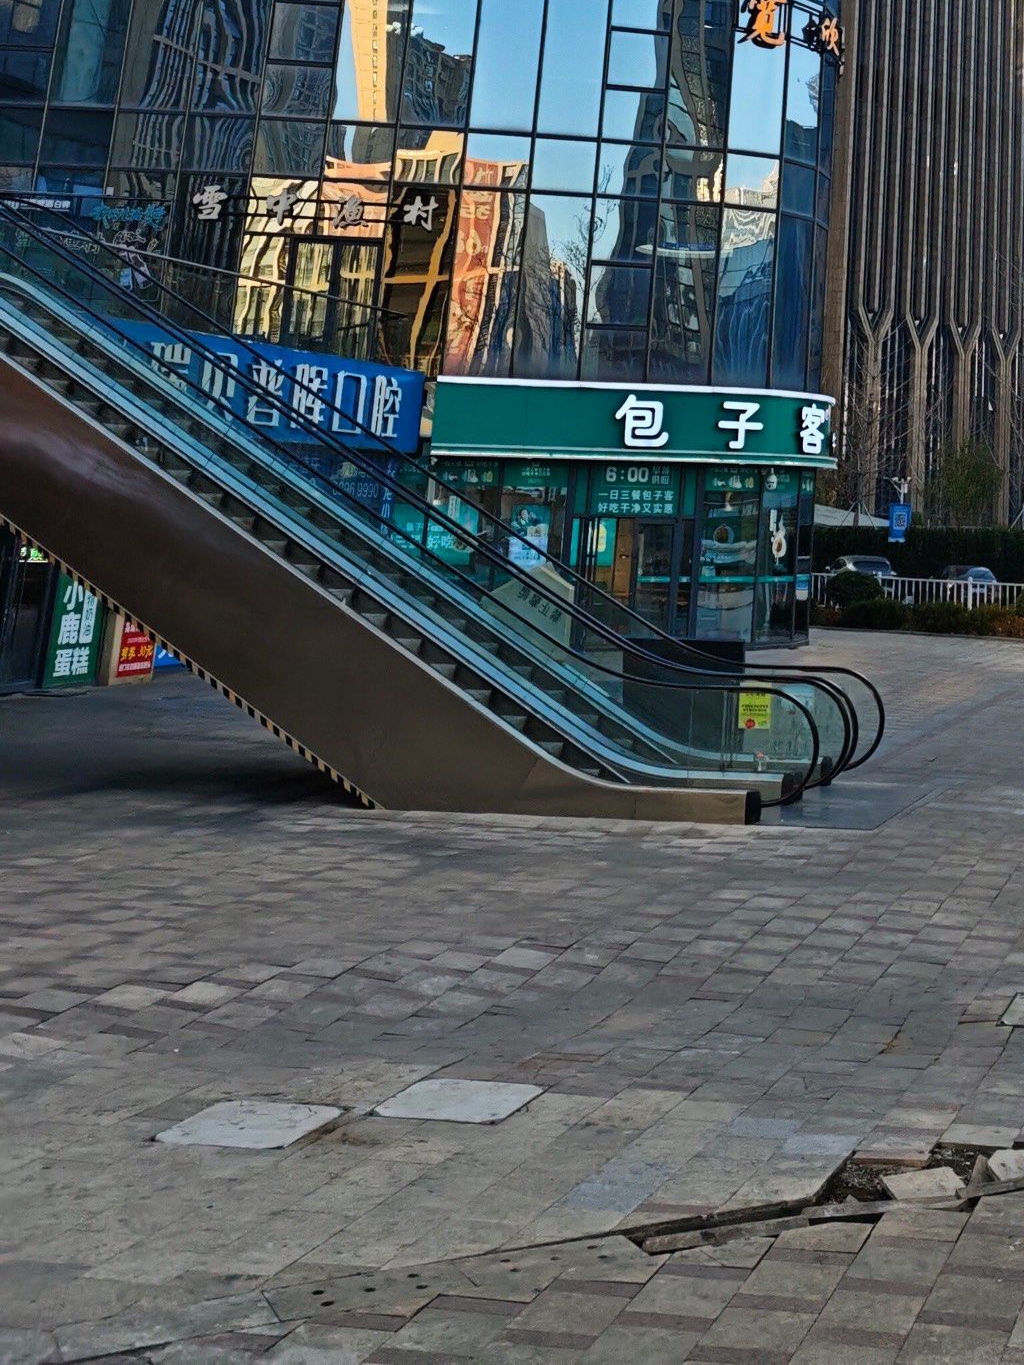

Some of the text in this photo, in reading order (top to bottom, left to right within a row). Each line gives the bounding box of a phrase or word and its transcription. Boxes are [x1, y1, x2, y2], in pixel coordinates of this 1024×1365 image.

[192, 184, 439, 232] 雪中渔村
[614, 393, 826, 455] 包子客
[605, 466, 649, 483] 6:00
[598, 489, 674, 501] 一日三餐包子客
[597, 502, 674, 514] 好吃干净又实惠
